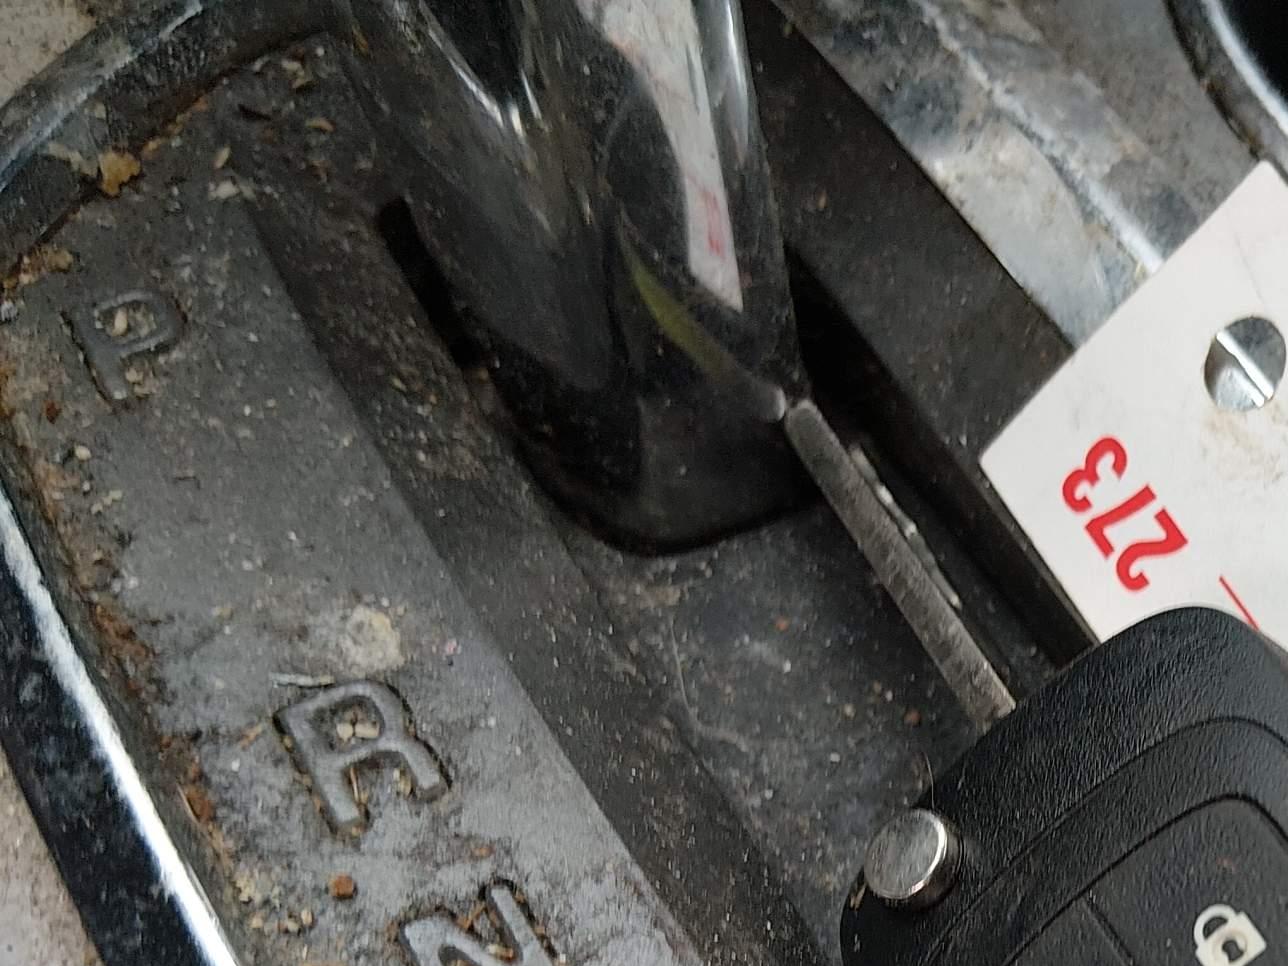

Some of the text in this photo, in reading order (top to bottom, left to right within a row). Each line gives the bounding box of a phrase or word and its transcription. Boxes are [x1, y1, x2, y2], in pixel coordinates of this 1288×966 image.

[62, 288, 186, 402] P
[1061, 436, 1189, 592] 273
[274, 678, 450, 834] R
